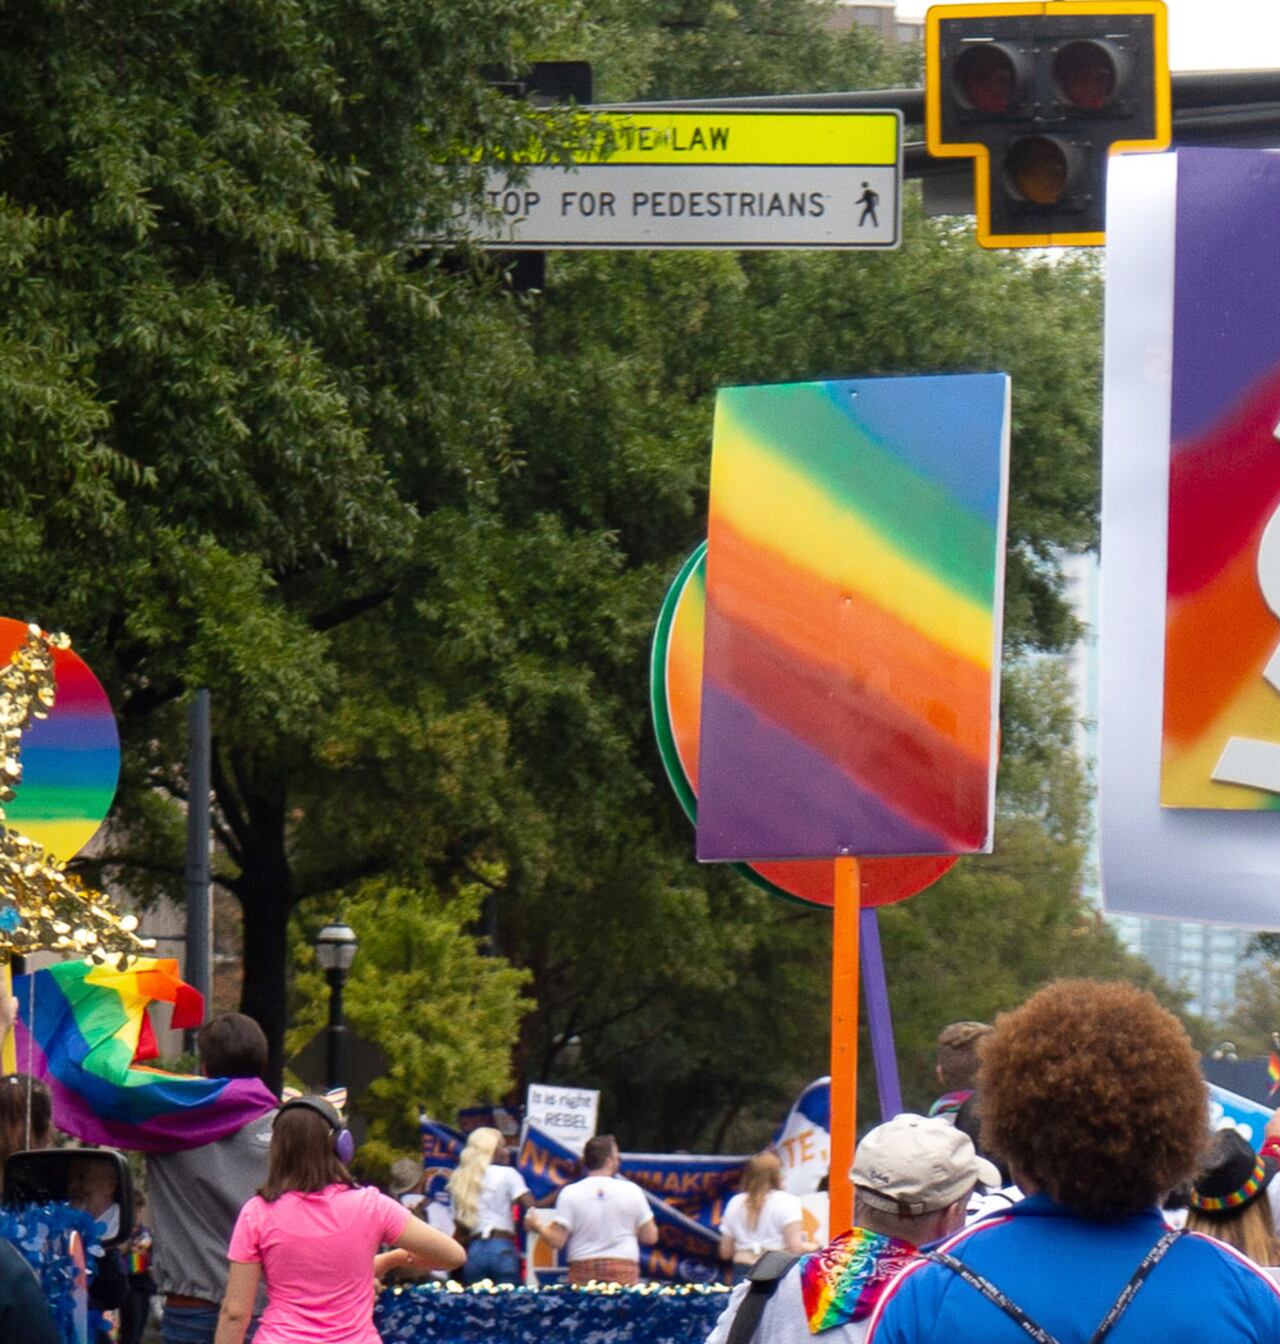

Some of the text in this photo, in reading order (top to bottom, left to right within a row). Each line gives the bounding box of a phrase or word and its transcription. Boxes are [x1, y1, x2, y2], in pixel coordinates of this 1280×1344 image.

[673, 127, 730, 150] LAW
[484, 191, 826, 217] TOP FOR PEDESTRIANS
